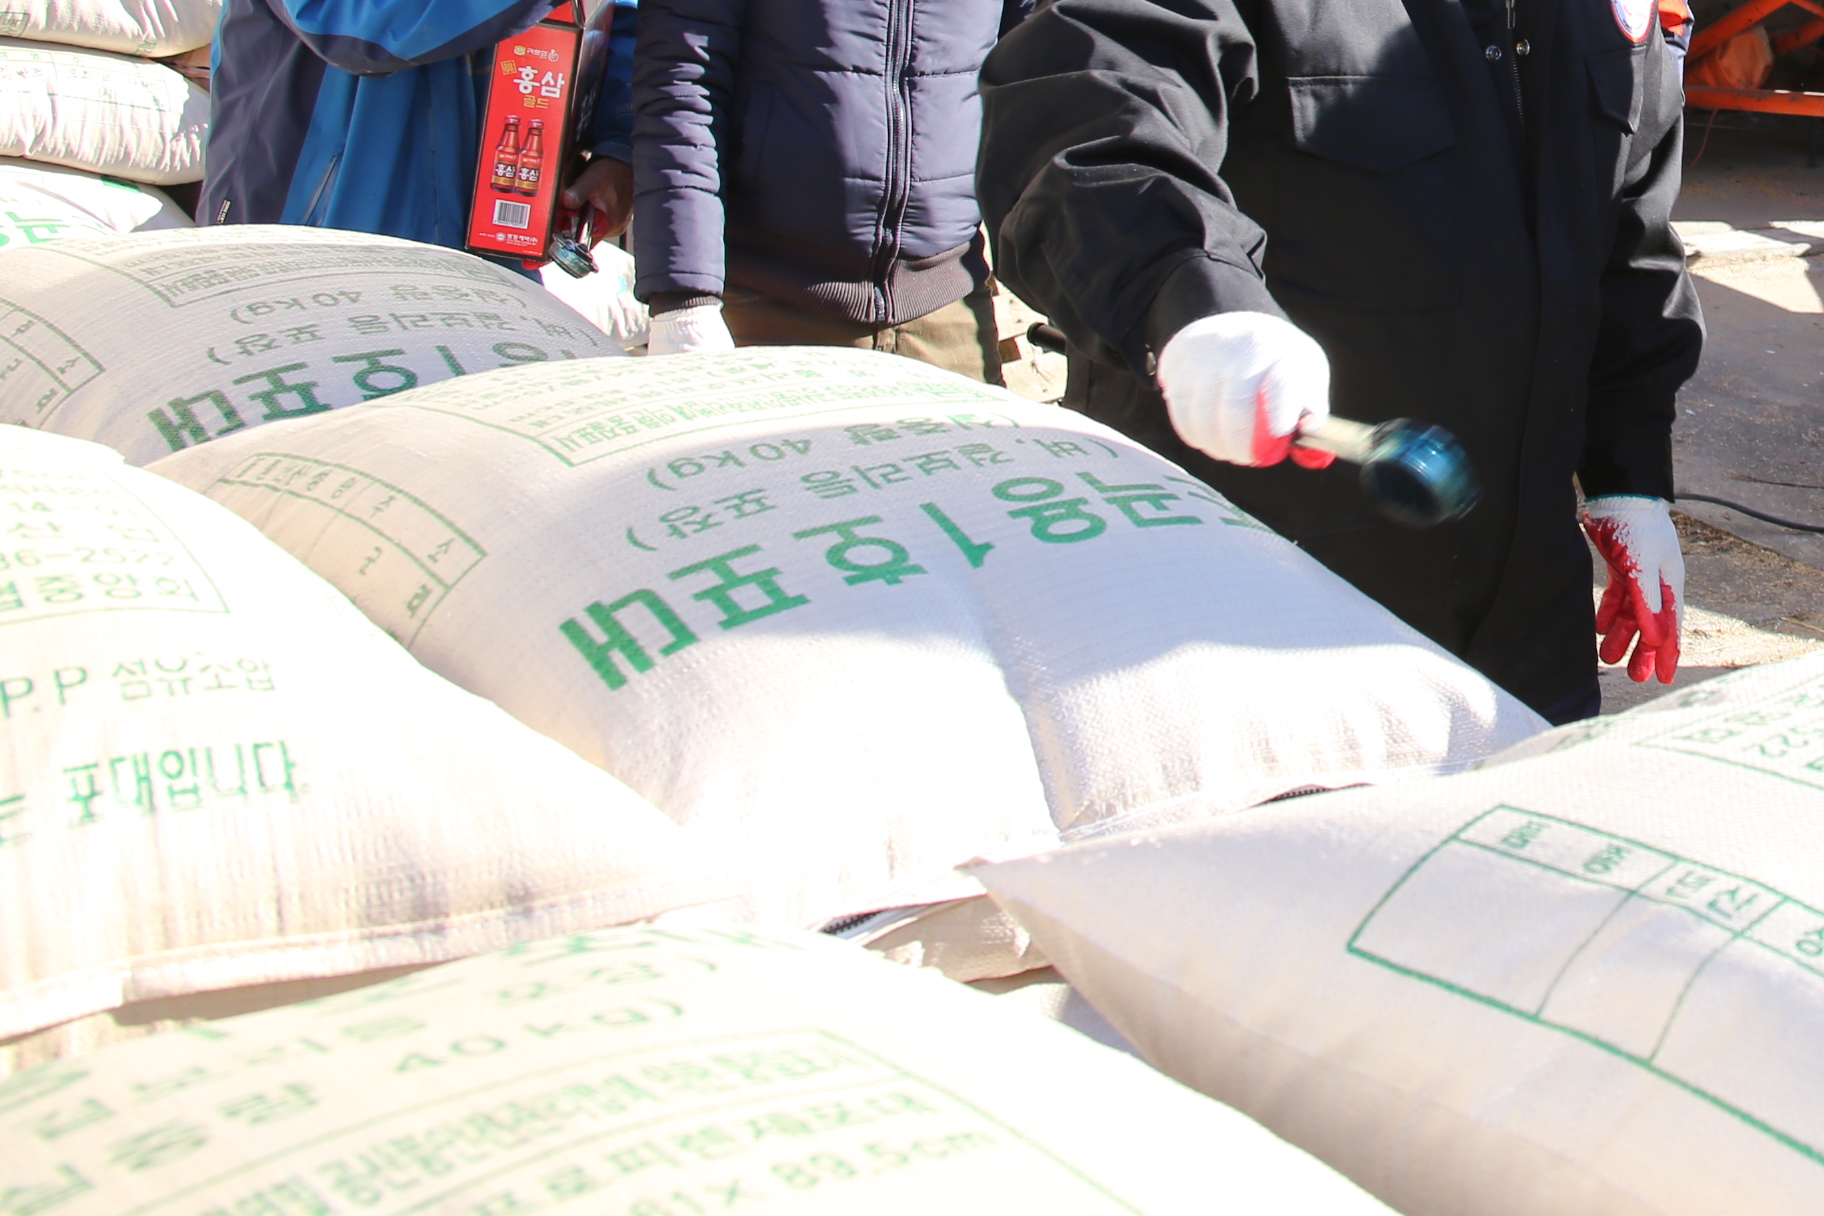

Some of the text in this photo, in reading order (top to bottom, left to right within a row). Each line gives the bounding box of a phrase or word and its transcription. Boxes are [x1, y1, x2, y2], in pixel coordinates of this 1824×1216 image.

[513, 65, 565, 98] 홍삼
[523, 95, 550, 109] 골드
[495, 163, 516, 177] 홍삼
[518, 167, 540, 182] 홍삼
[230, 289, 363, 325] 40kg)
[206, 323, 326, 366] 포장)
[647, 436, 814, 492] 40kg)
[626, 487, 778, 553] 포장)
